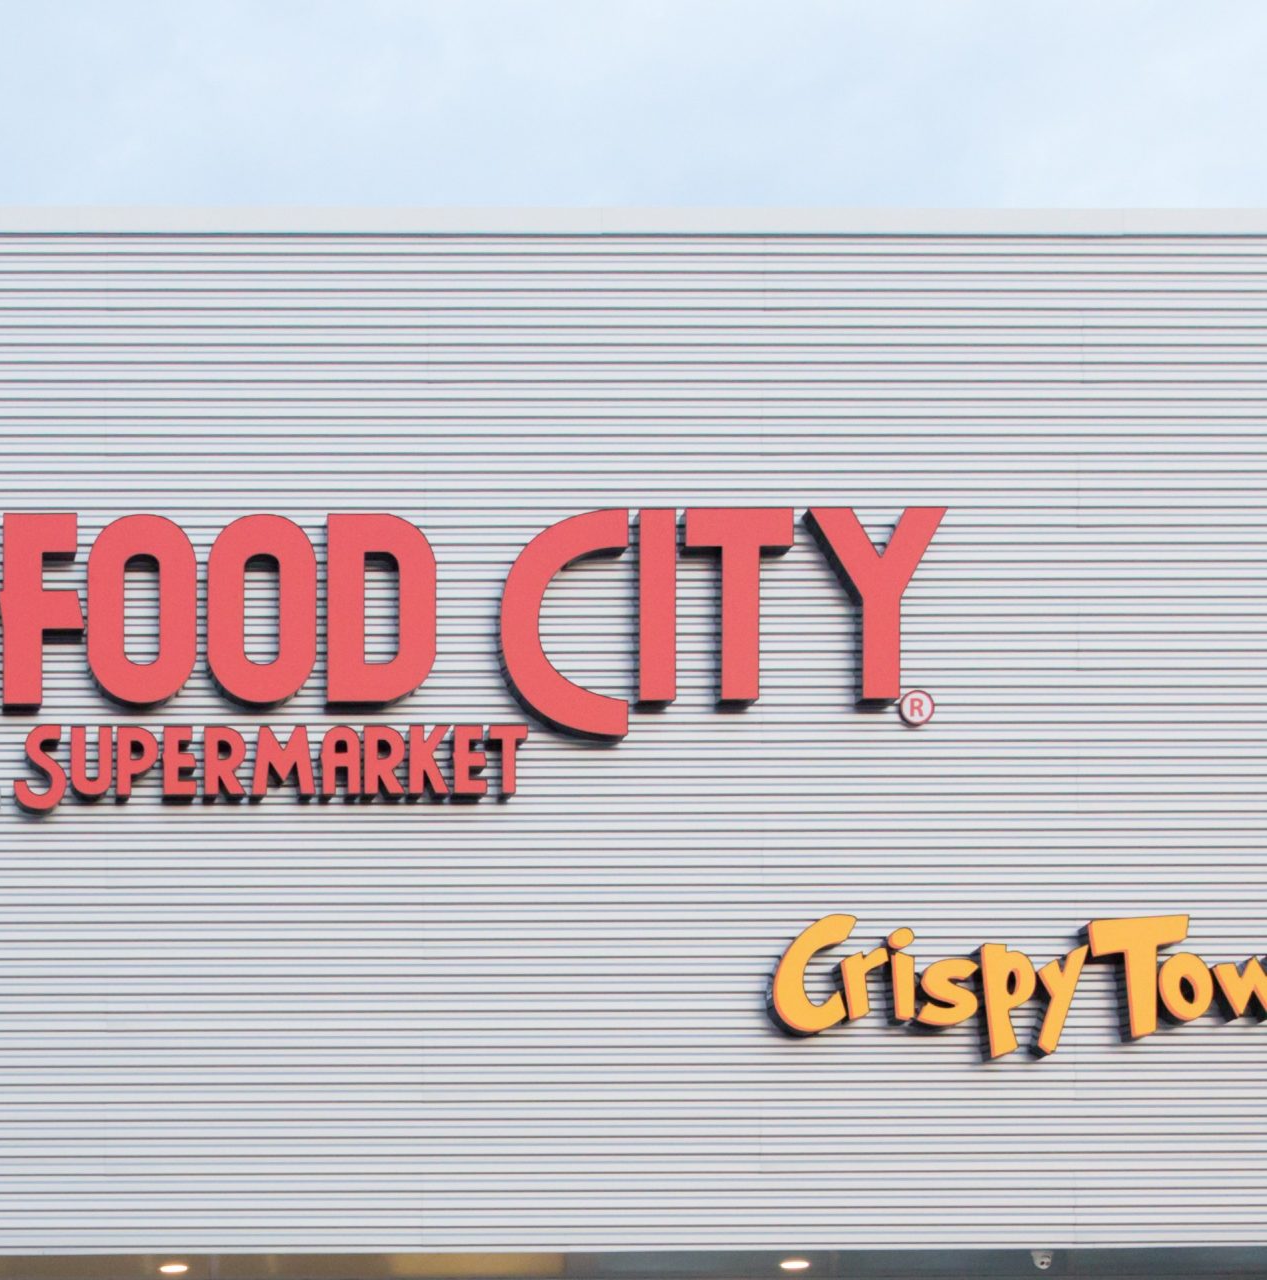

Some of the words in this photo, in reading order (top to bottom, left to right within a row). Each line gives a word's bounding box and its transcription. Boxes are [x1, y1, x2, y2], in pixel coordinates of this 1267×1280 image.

[499, 507, 948, 738] CITY
[12, 723, 530, 812] SUPERMARKET
[768, 913, 1089, 1060] Crispy
